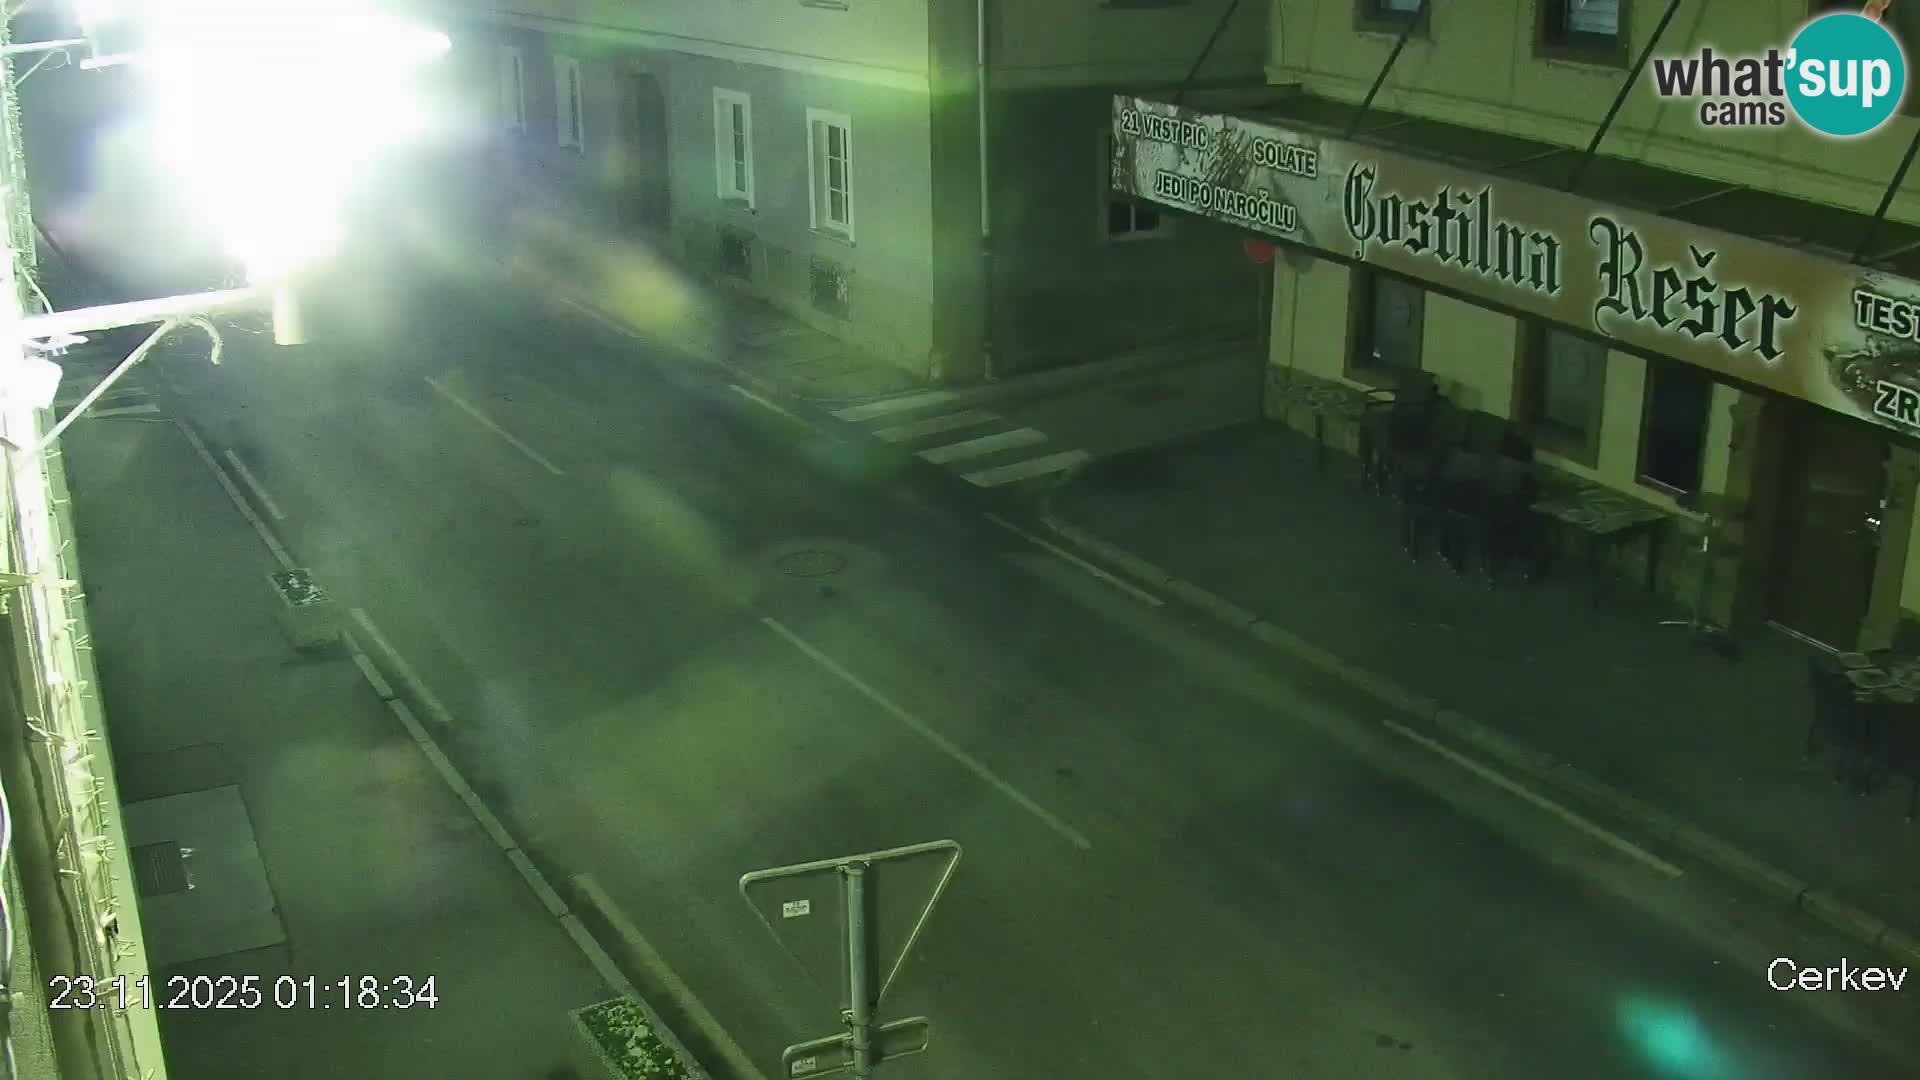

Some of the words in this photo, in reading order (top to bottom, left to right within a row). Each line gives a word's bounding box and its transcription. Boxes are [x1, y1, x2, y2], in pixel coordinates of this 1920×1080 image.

[1122, 109, 1140, 134] 21
[1143, 114, 1180, 143] VRST
[1182, 122, 1208, 149] PIC
[1254, 138, 1318, 178] SOLATE
[1155, 171, 1186, 202] JEDI
[1190, 180, 1212, 207] PO
[1214, 189, 1298, 231] NAROČILU
[1344, 161, 1560, 294] Gostilna
[1589, 217, 1798, 361] Rešer
